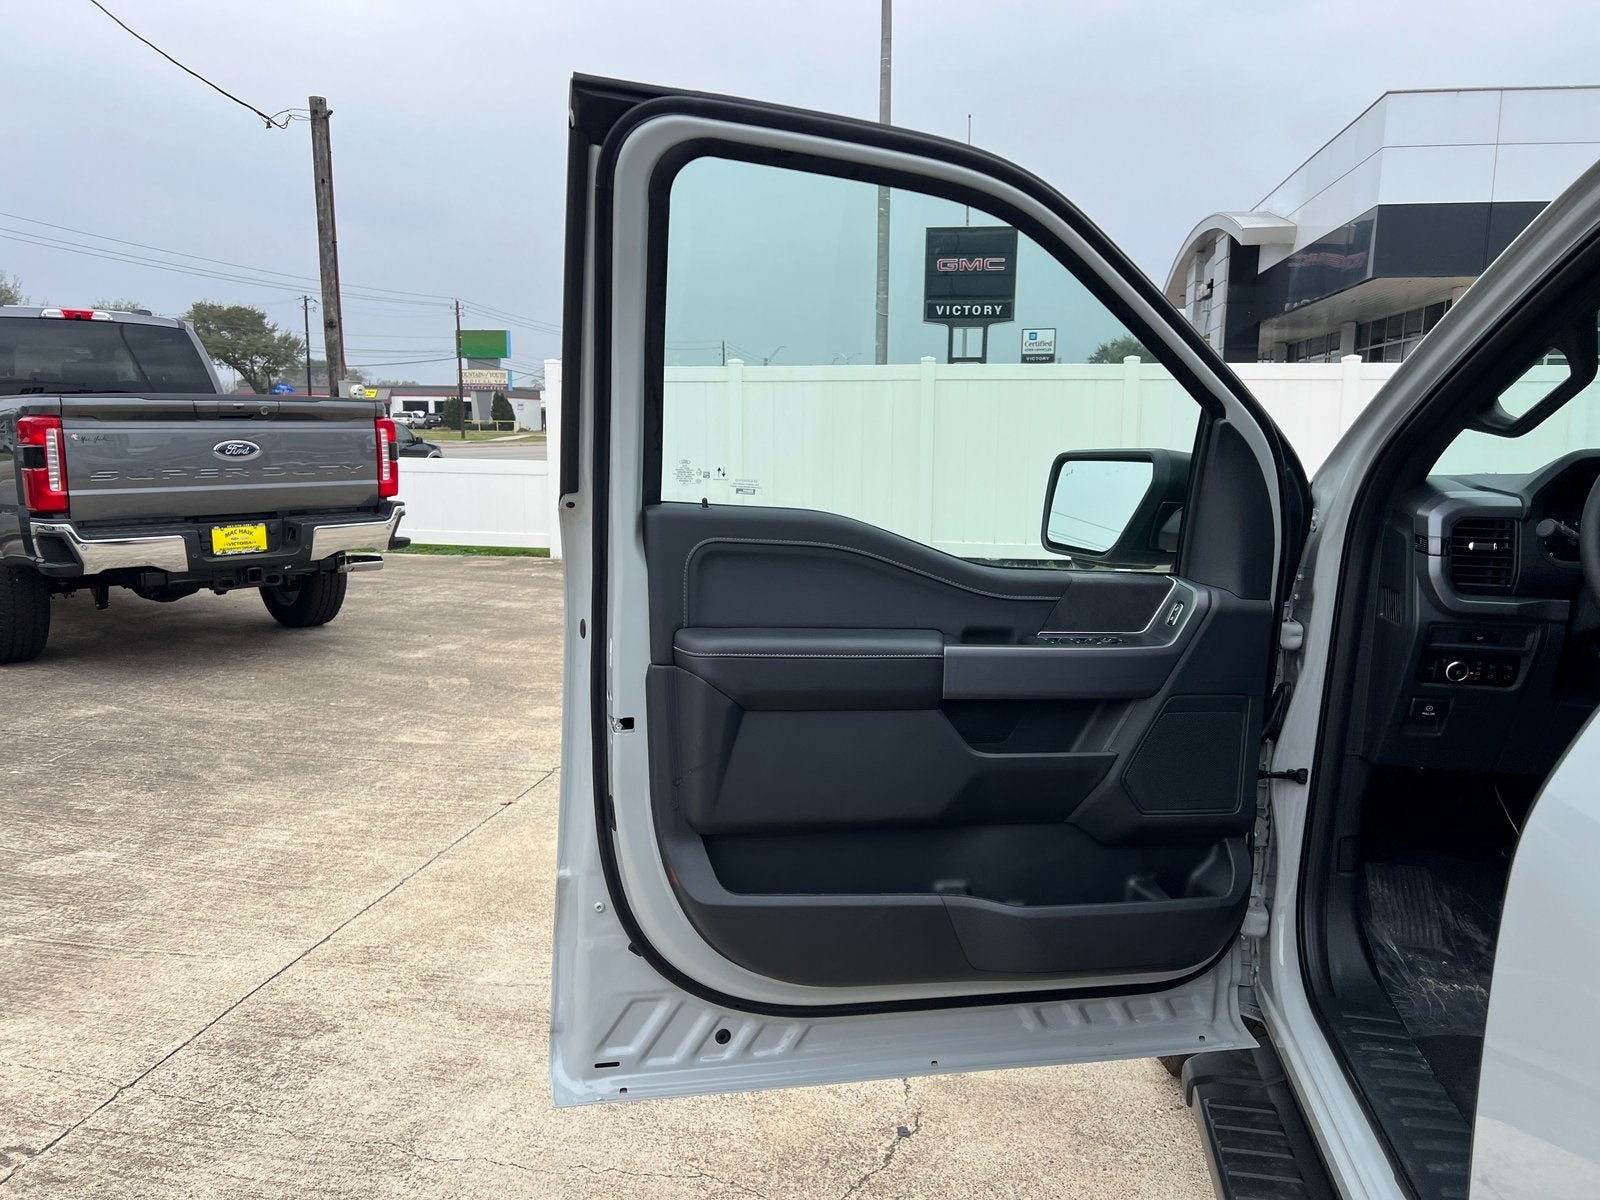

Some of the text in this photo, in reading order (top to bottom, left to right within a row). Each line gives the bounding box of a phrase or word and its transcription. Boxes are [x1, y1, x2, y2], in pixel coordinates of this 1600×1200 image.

[937, 258, 1005, 271] GMC
[936, 305, 1003, 315] VICTORY
[224, 444, 251, 457] Ford
[90, 464, 364, 482] SUPER DUTY
